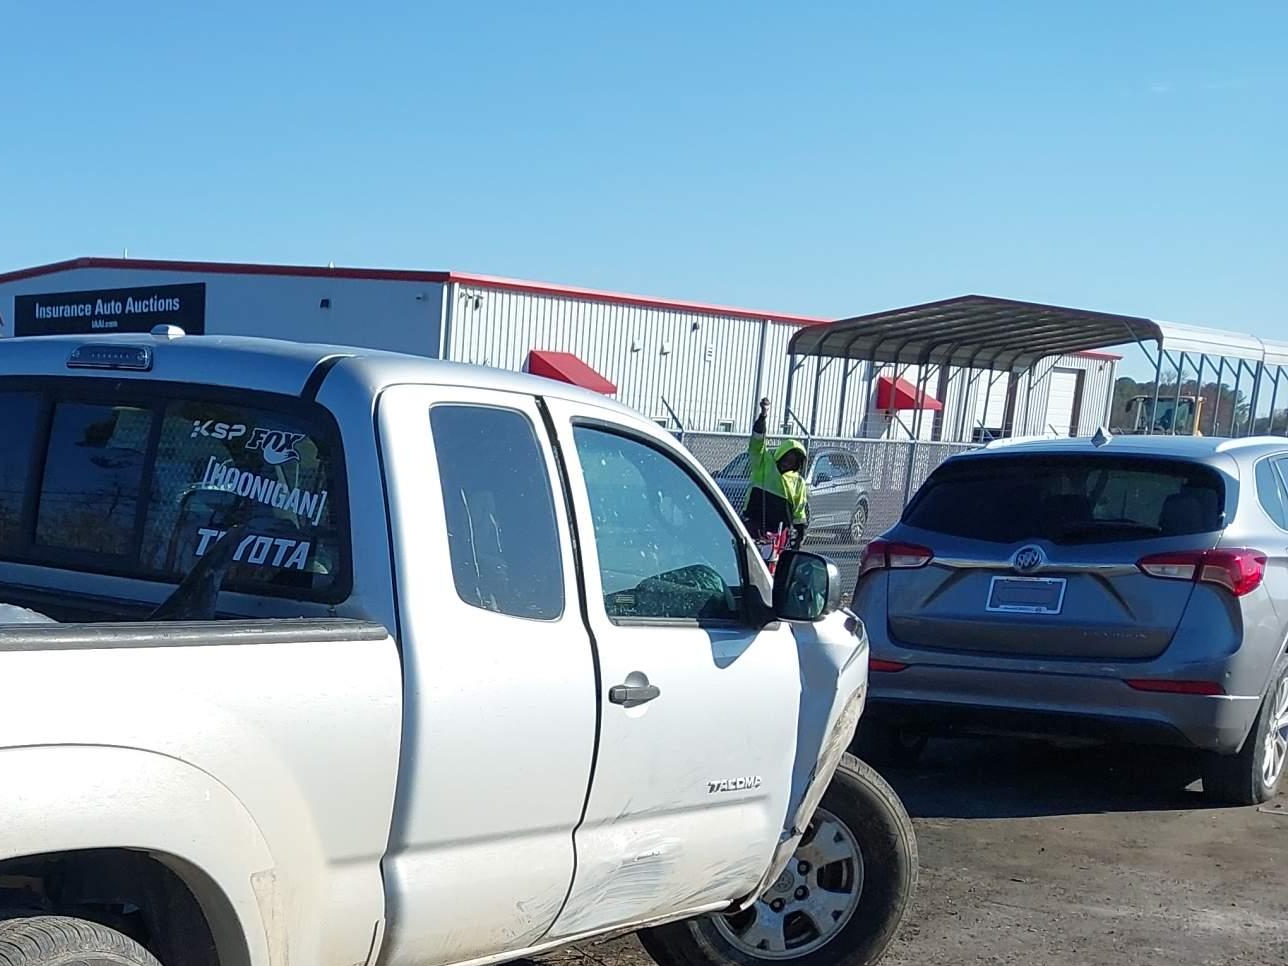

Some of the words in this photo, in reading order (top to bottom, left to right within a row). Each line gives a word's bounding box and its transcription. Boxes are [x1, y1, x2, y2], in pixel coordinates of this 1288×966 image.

[35, 303, 91, 319] Insurance
[95, 299, 122, 316] Auto
[125, 295, 180, 314] Auctions
[245, 427, 306, 452] FOX
[195, 528, 311, 570] TYOTA
